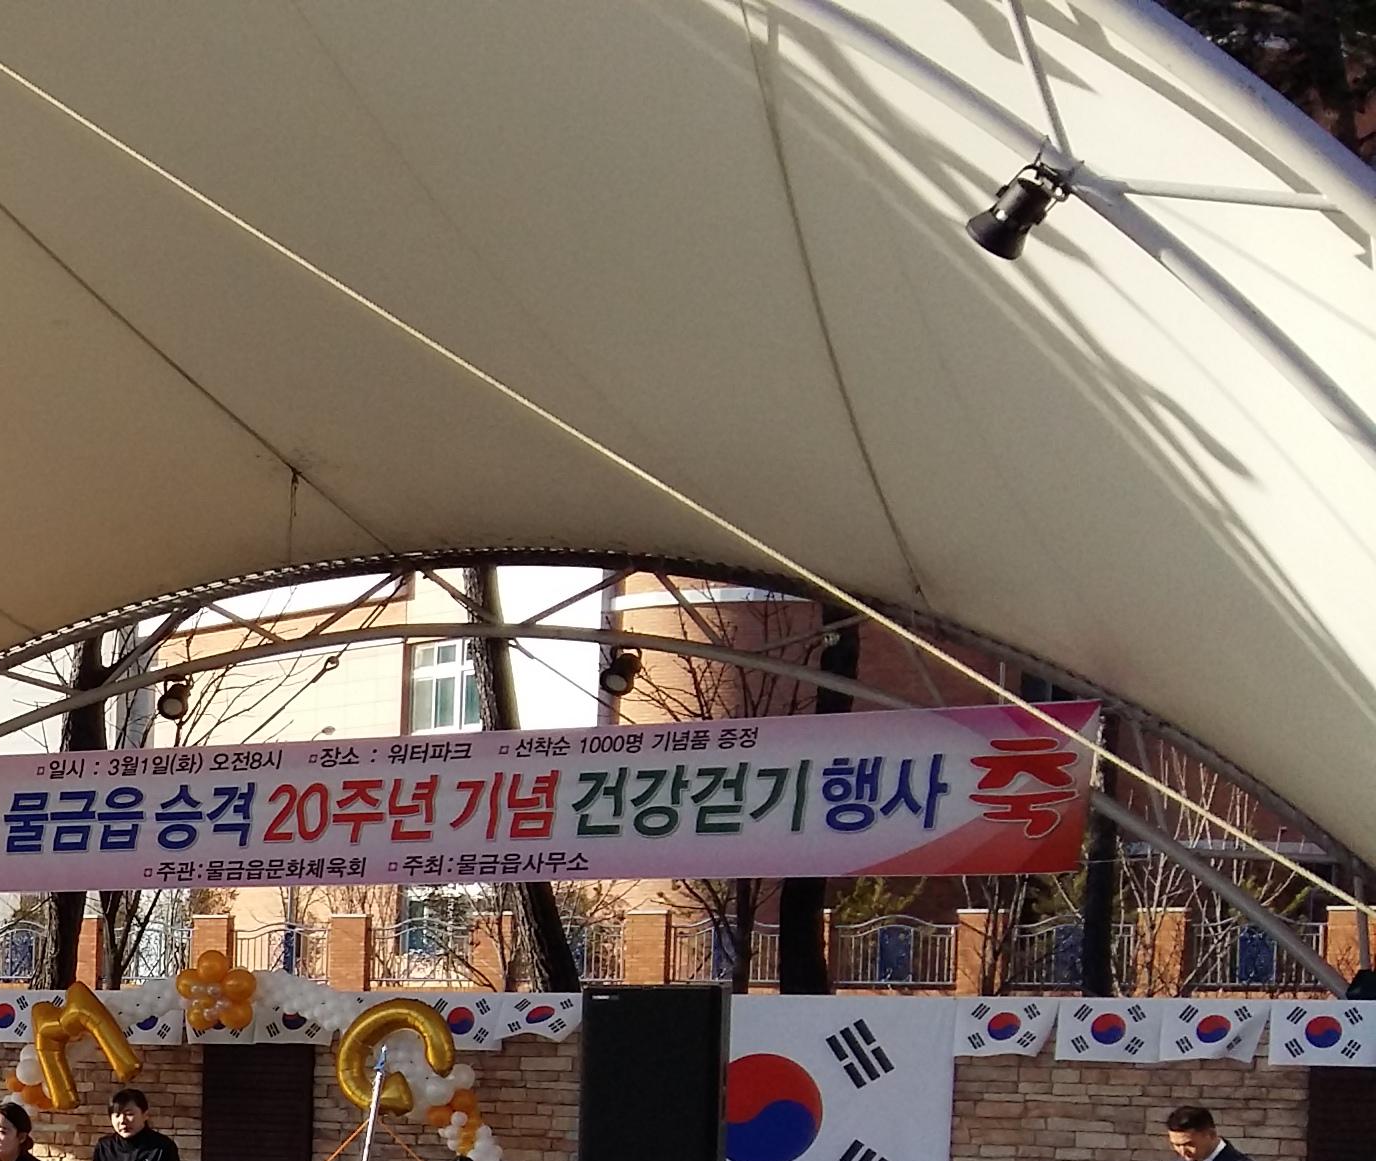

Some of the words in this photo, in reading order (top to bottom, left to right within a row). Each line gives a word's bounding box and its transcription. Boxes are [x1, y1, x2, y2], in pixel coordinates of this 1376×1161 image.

[320, 746, 360, 767] 장소
[388, 741, 472, 765] 워터파크
[515, 736, 571, 757] 선착순
[580, 732, 643, 754] 1000명
[652, 730, 710, 751] 기념품
[718, 726, 759, 749] 증정
[49, 758, 85, 779] 일시
[107, 752, 203, 777] 3월1일(화)
[209, 750, 283, 772] 오전8시
[4, 786, 145, 853] 물금읍
[155, 782, 257, 849] 승격
[263, 774, 439, 844] 20주년
[450, 770, 560, 840] 기념
[572, 761, 810, 837] 건강걷기
[822, 753, 949, 832] 행사
[969, 737, 1080, 839] 축
